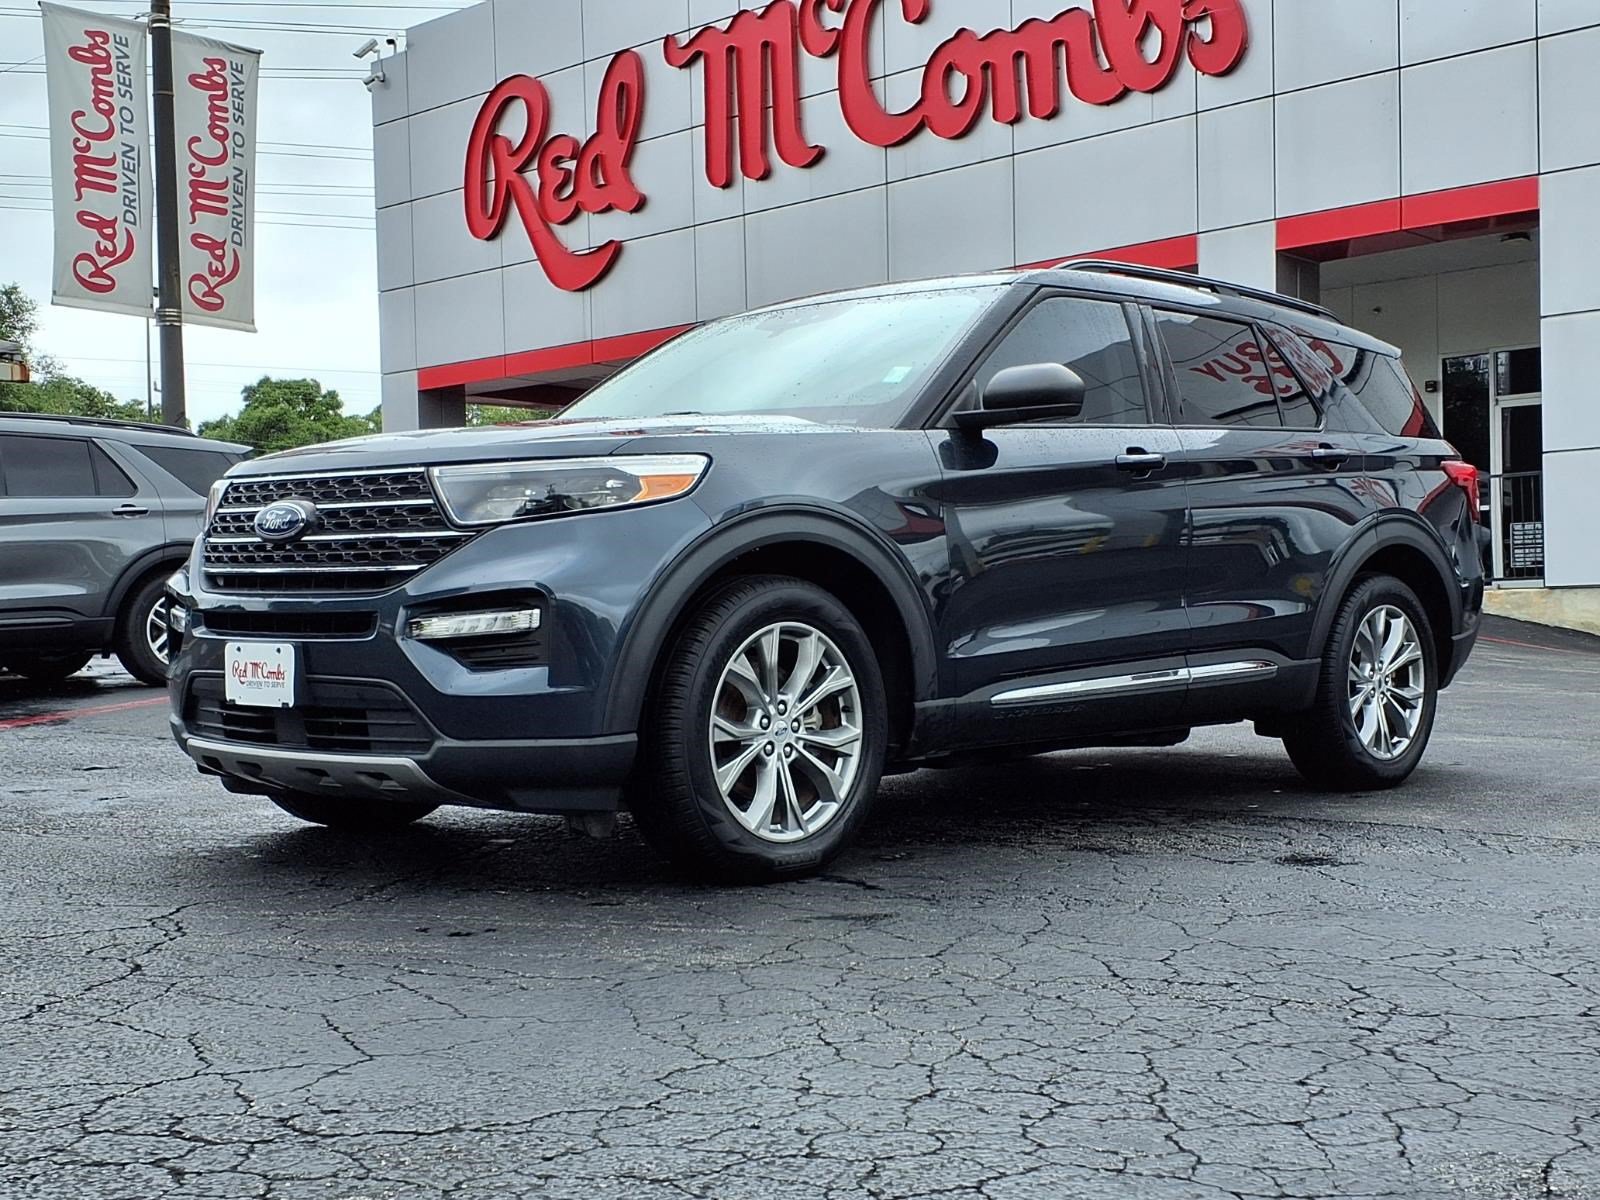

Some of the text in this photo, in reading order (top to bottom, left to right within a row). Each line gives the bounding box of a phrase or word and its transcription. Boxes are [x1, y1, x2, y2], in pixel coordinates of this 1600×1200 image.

[68, 29, 135, 293] Red McCombs
[113, 33, 138, 227] DRIVEN TO SERVE
[187, 57, 240, 312] Red McCombs
[230, 60, 246, 247] DRIVEN TO SERVE
[464, 0, 1248, 292] Red McCombs
[263, 510, 292, 529] Ford
[232, 660, 286, 684] Red McCombs
